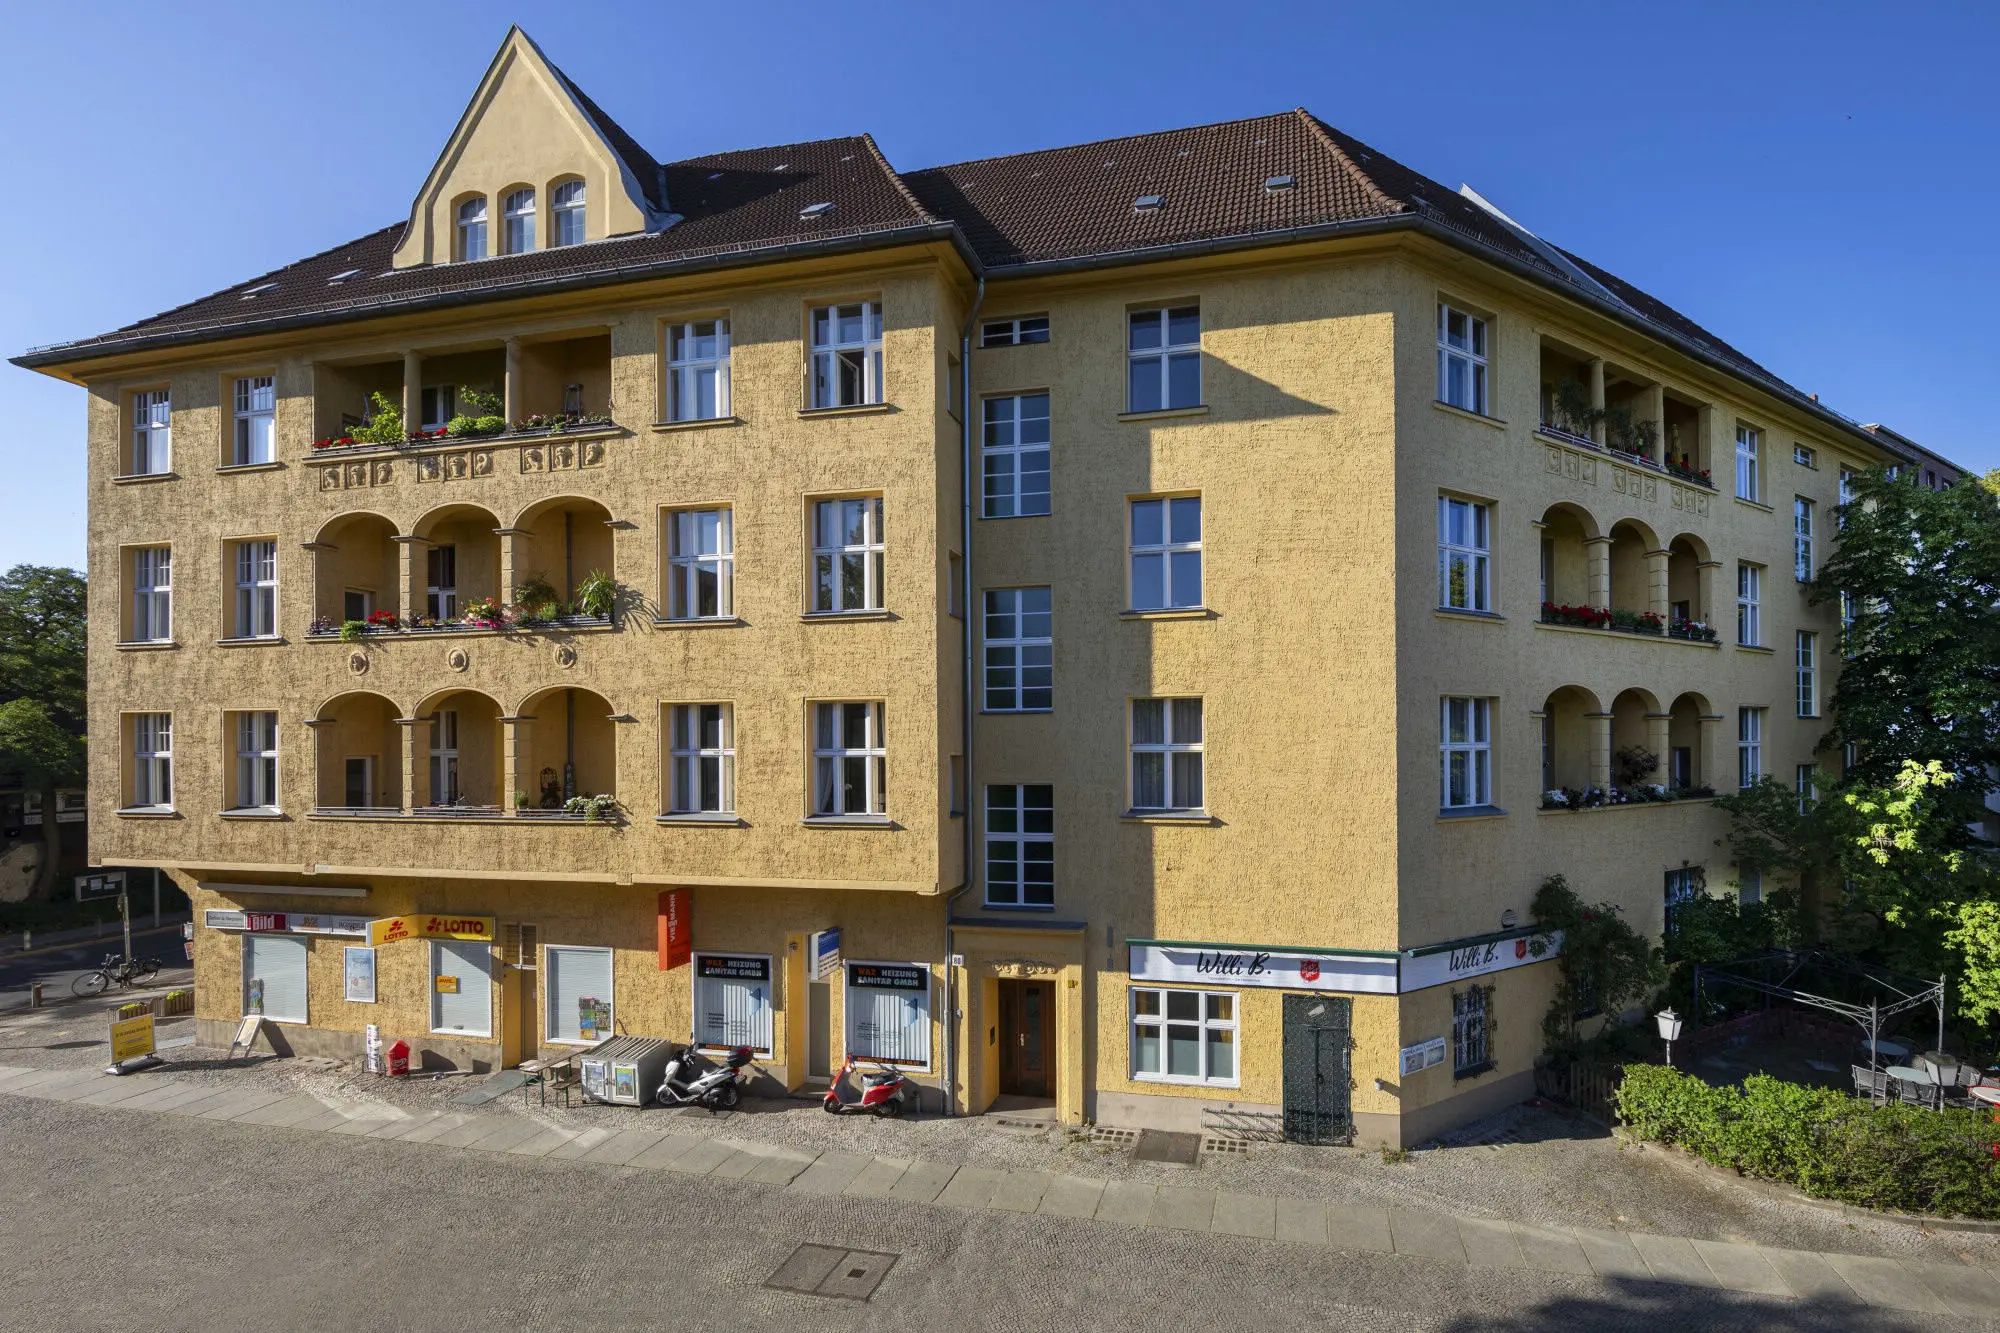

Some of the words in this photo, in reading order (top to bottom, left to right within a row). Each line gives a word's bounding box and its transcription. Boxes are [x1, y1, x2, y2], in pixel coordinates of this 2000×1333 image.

[252, 914, 275, 931] Bild
[667, 894, 678, 942] VIESSMANN
[443, 919, 485, 934] LOTTO
[383, 931, 408, 941] LOTTO
[1196, 951, 1243, 976] Willi
[1247, 952, 1272, 975] B.
[1448, 946, 1482, 972] Willi
[1482, 940, 1499, 966] B.
[727, 960, 761, 969] HEIZUNG
[857, 967, 877, 976] WAZ
[881, 969, 919, 978] HEIZUNG
[893, 978, 919, 987] GMBH
